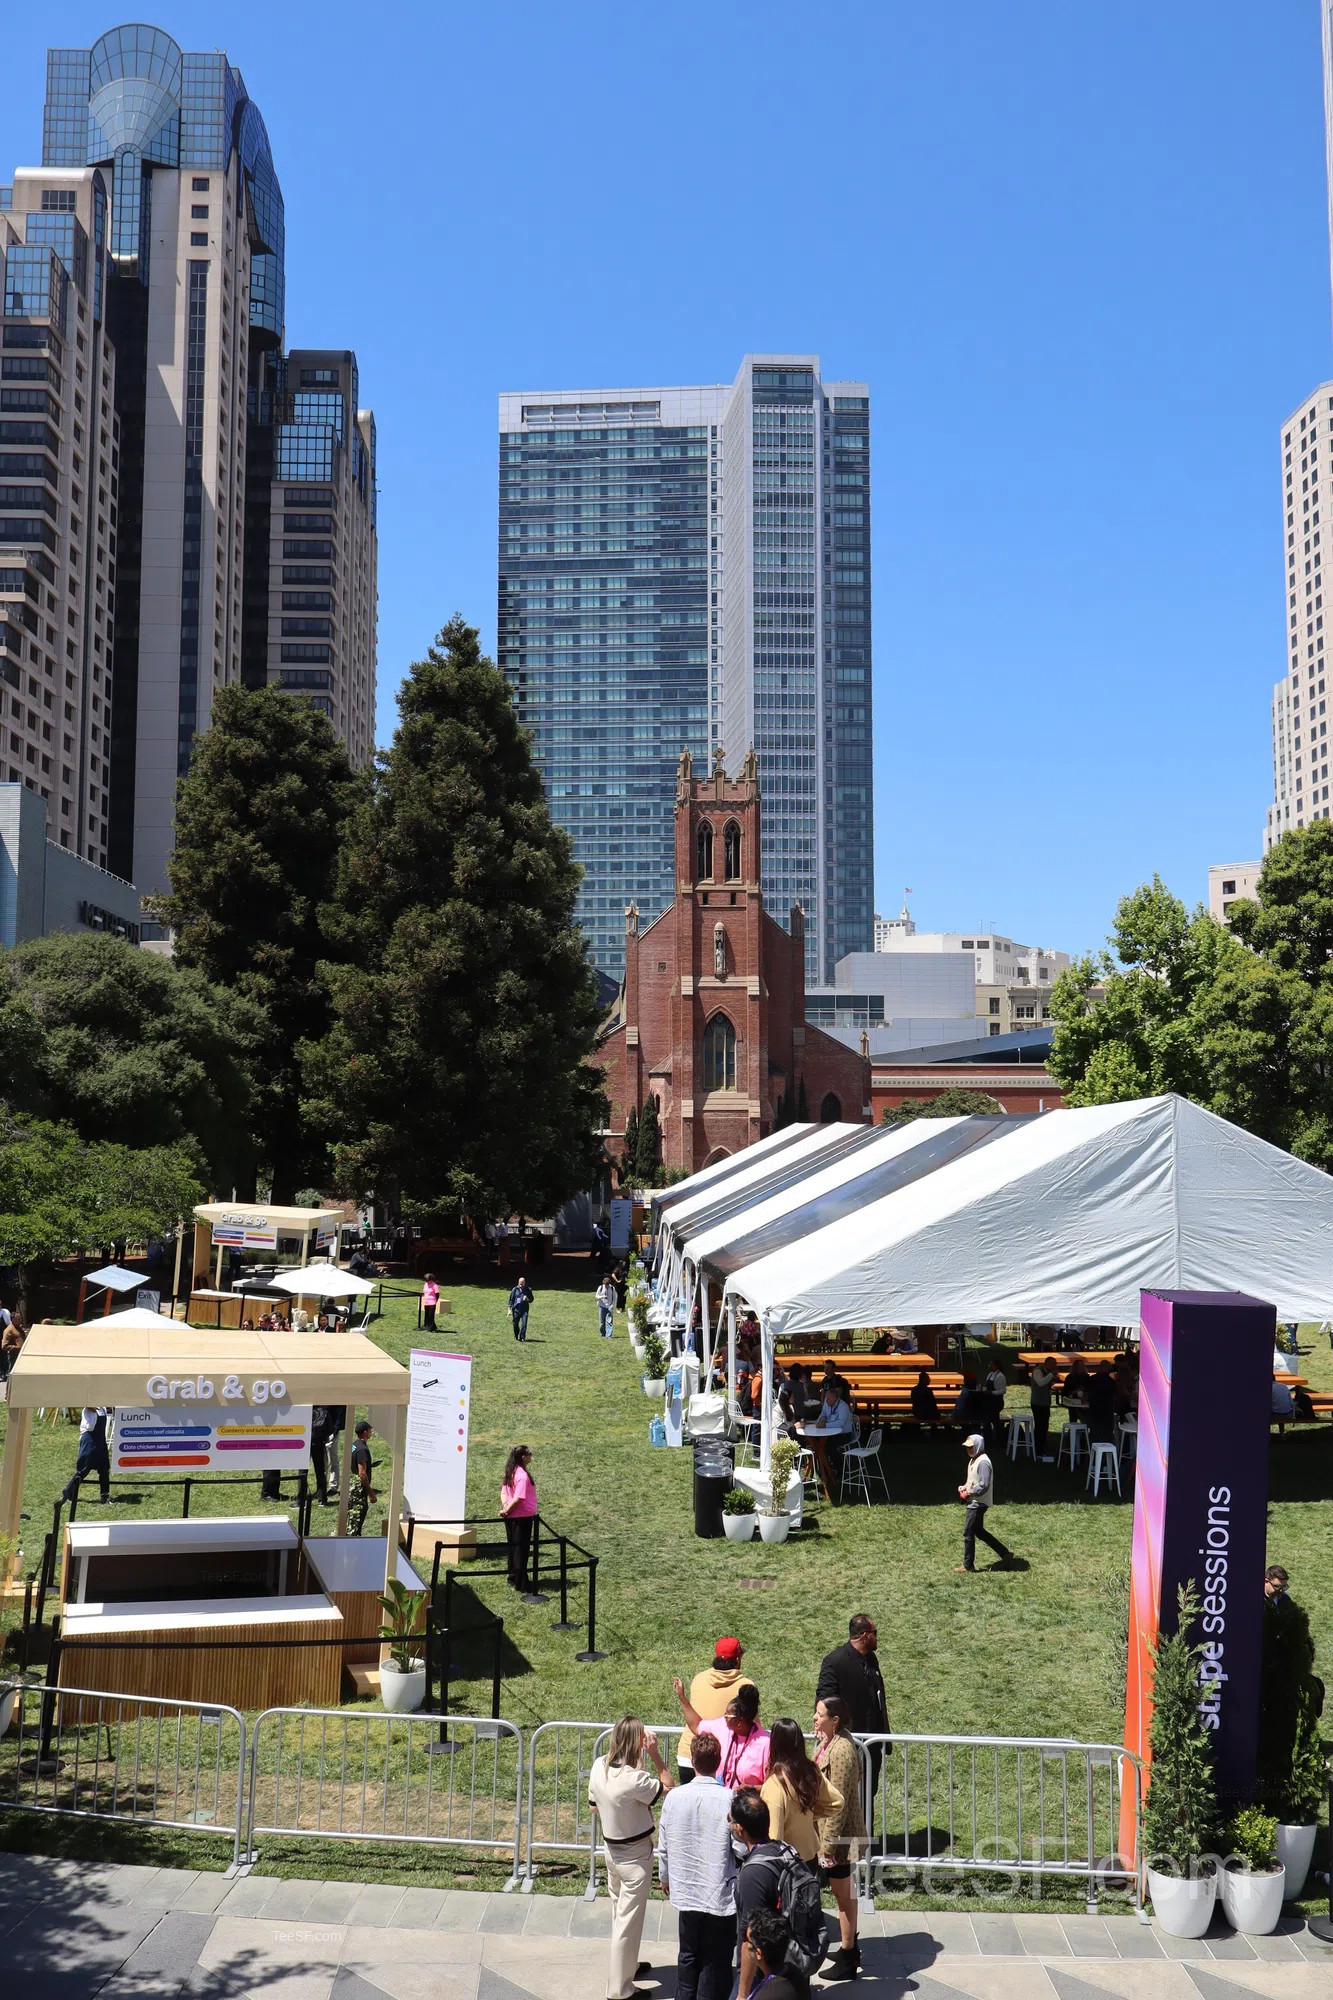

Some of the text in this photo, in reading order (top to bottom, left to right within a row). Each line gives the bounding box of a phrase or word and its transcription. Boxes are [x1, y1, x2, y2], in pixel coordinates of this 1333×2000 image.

[221, 1212, 243, 1224] Grab
[246, 1215, 253, 1225] &
[138, 1291, 152, 1300] Exit
[413, 1359, 432, 1368] Lunch
[147, 1375, 287, 1403] Grab & go
[120, 1412, 151, 1422] Lunch
[1198, 1485, 1232, 1636] sessions
